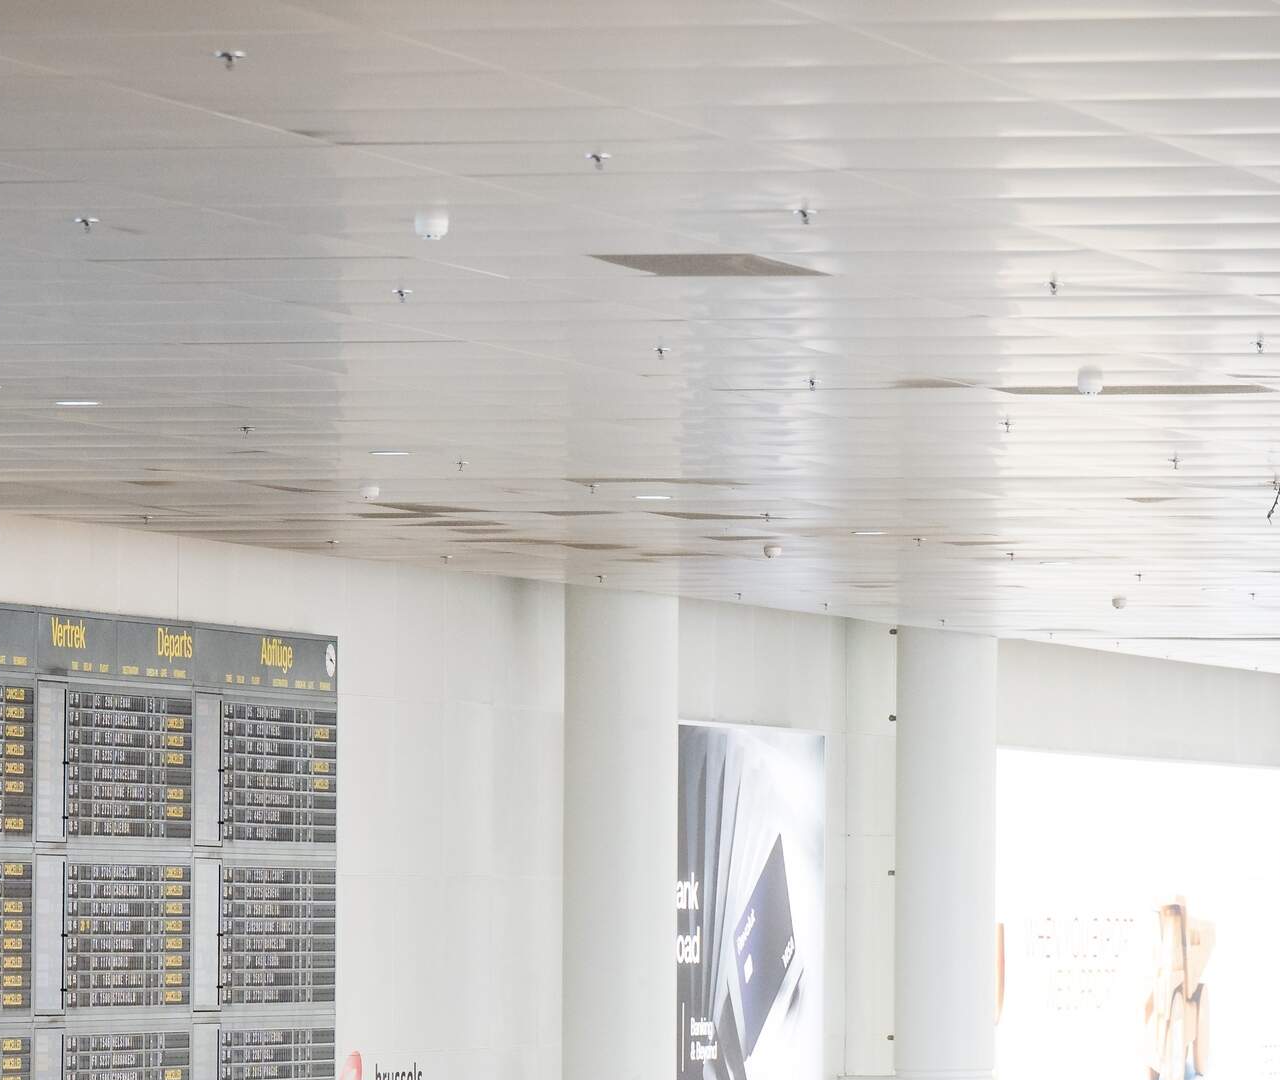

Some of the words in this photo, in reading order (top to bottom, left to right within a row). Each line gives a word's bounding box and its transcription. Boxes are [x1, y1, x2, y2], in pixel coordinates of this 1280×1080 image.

[51, 616, 86, 649] Vertrek
[157, 627, 192, 663] Départs
[260, 637, 293, 675] Abflüge
[676, 872, 699, 911] ank
[677, 926, 701, 964] oad
